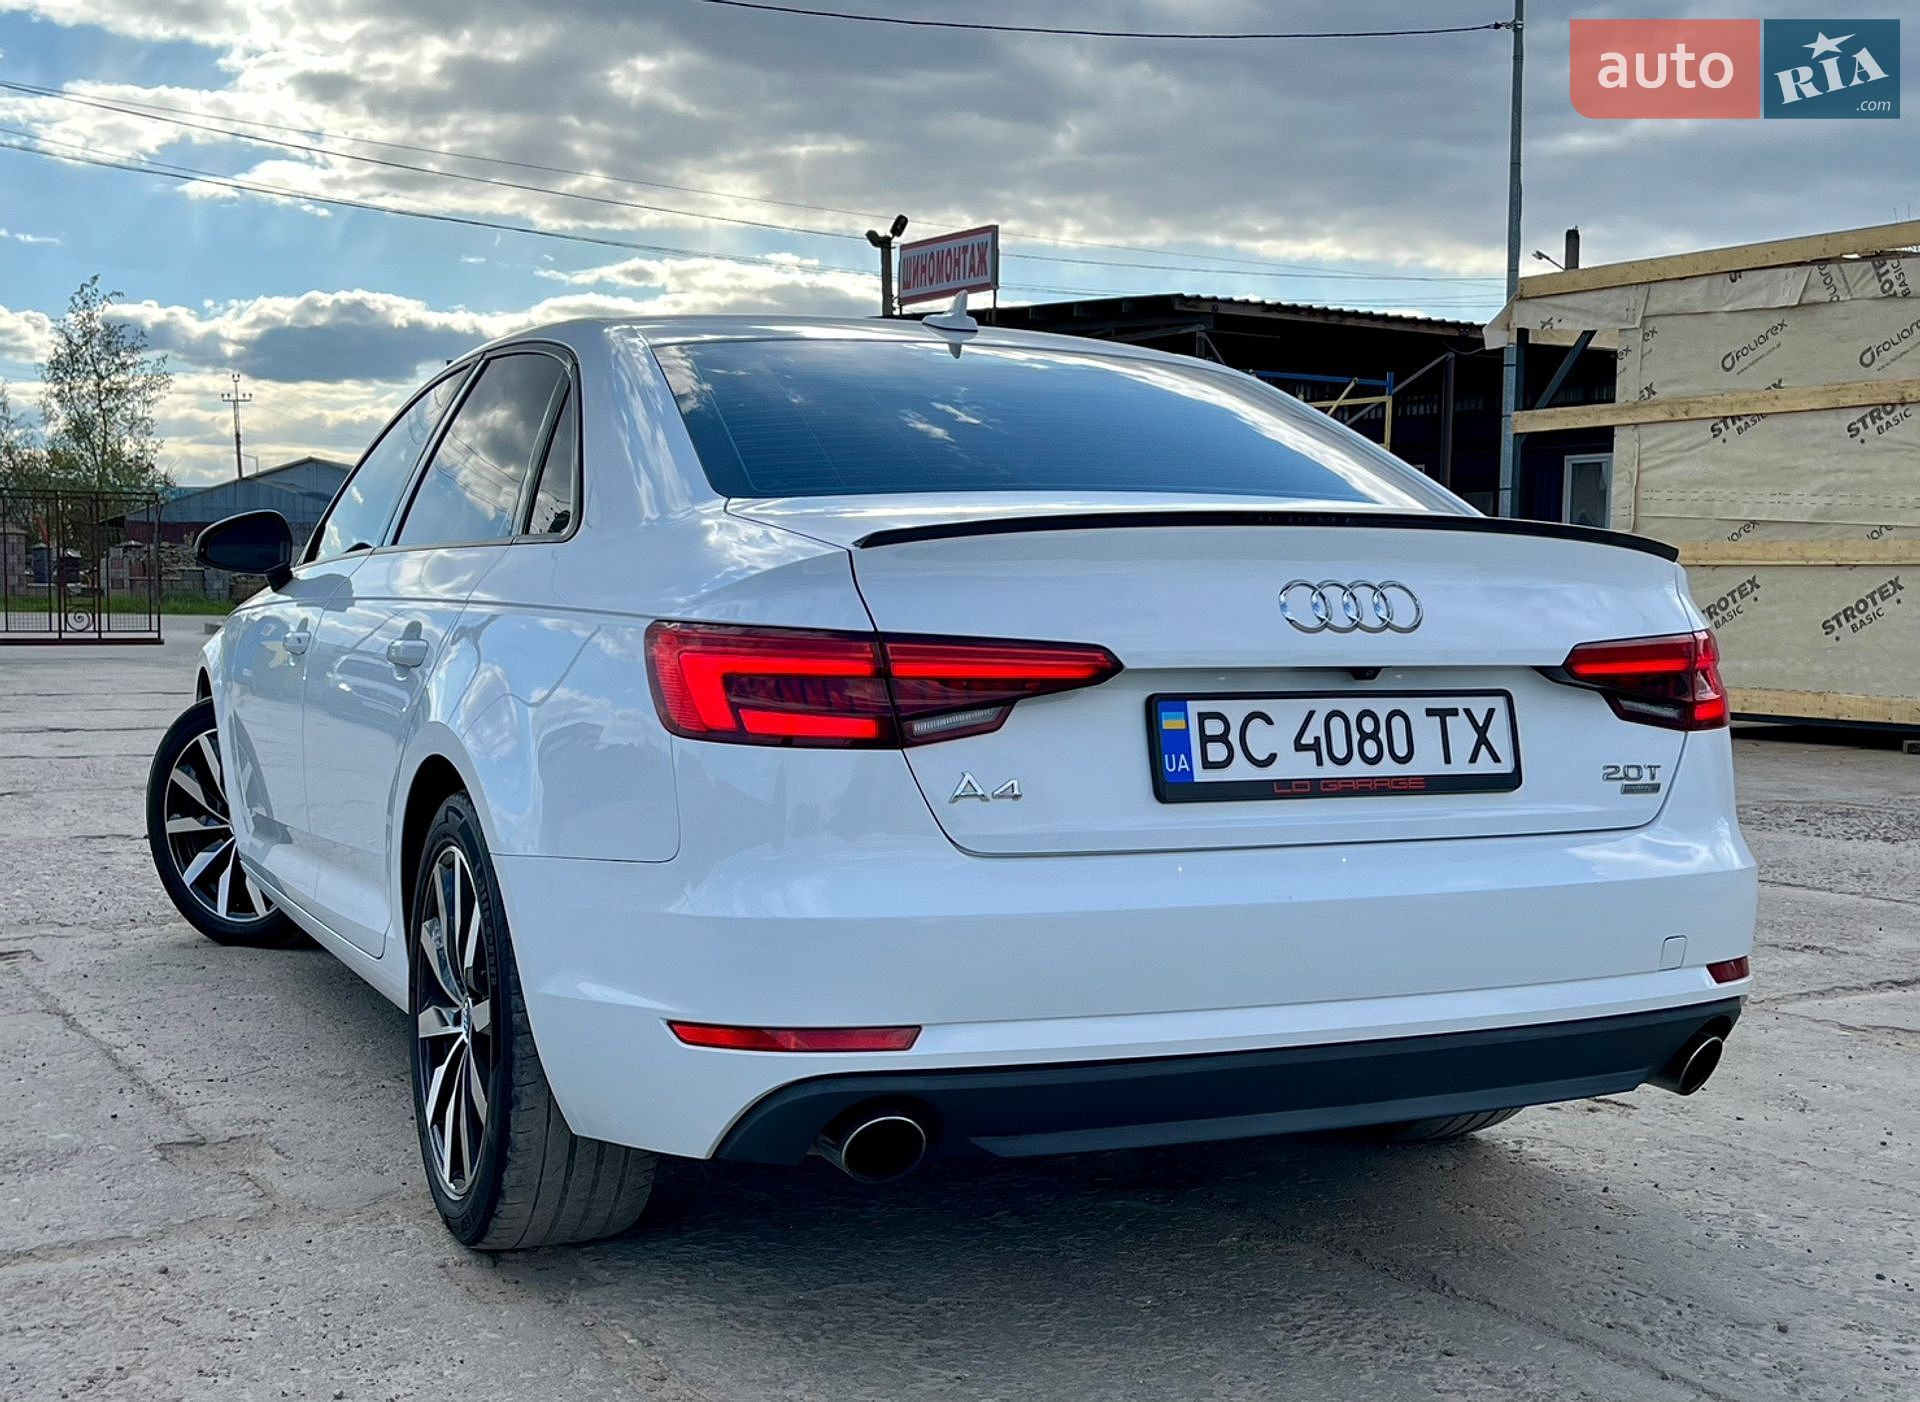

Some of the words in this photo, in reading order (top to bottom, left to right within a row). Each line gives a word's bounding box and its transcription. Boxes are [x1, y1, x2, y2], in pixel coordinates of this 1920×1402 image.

[902, 241, 988, 290] ШИНОМОНТАЖ
[1713, 605, 1744, 629] BASIC
[1821, 575, 1905, 636] STROTEX
[1850, 607, 1885, 634] BASIC
[1197, 711, 1277, 770] BC
[1294, 709, 1414, 767] 4080
[1425, 707, 1502, 765] TX
[1164, 753, 1190, 772] UA
[948, 771, 1022, 804] A4
[1320, 778, 1425, 792] GARAGE
